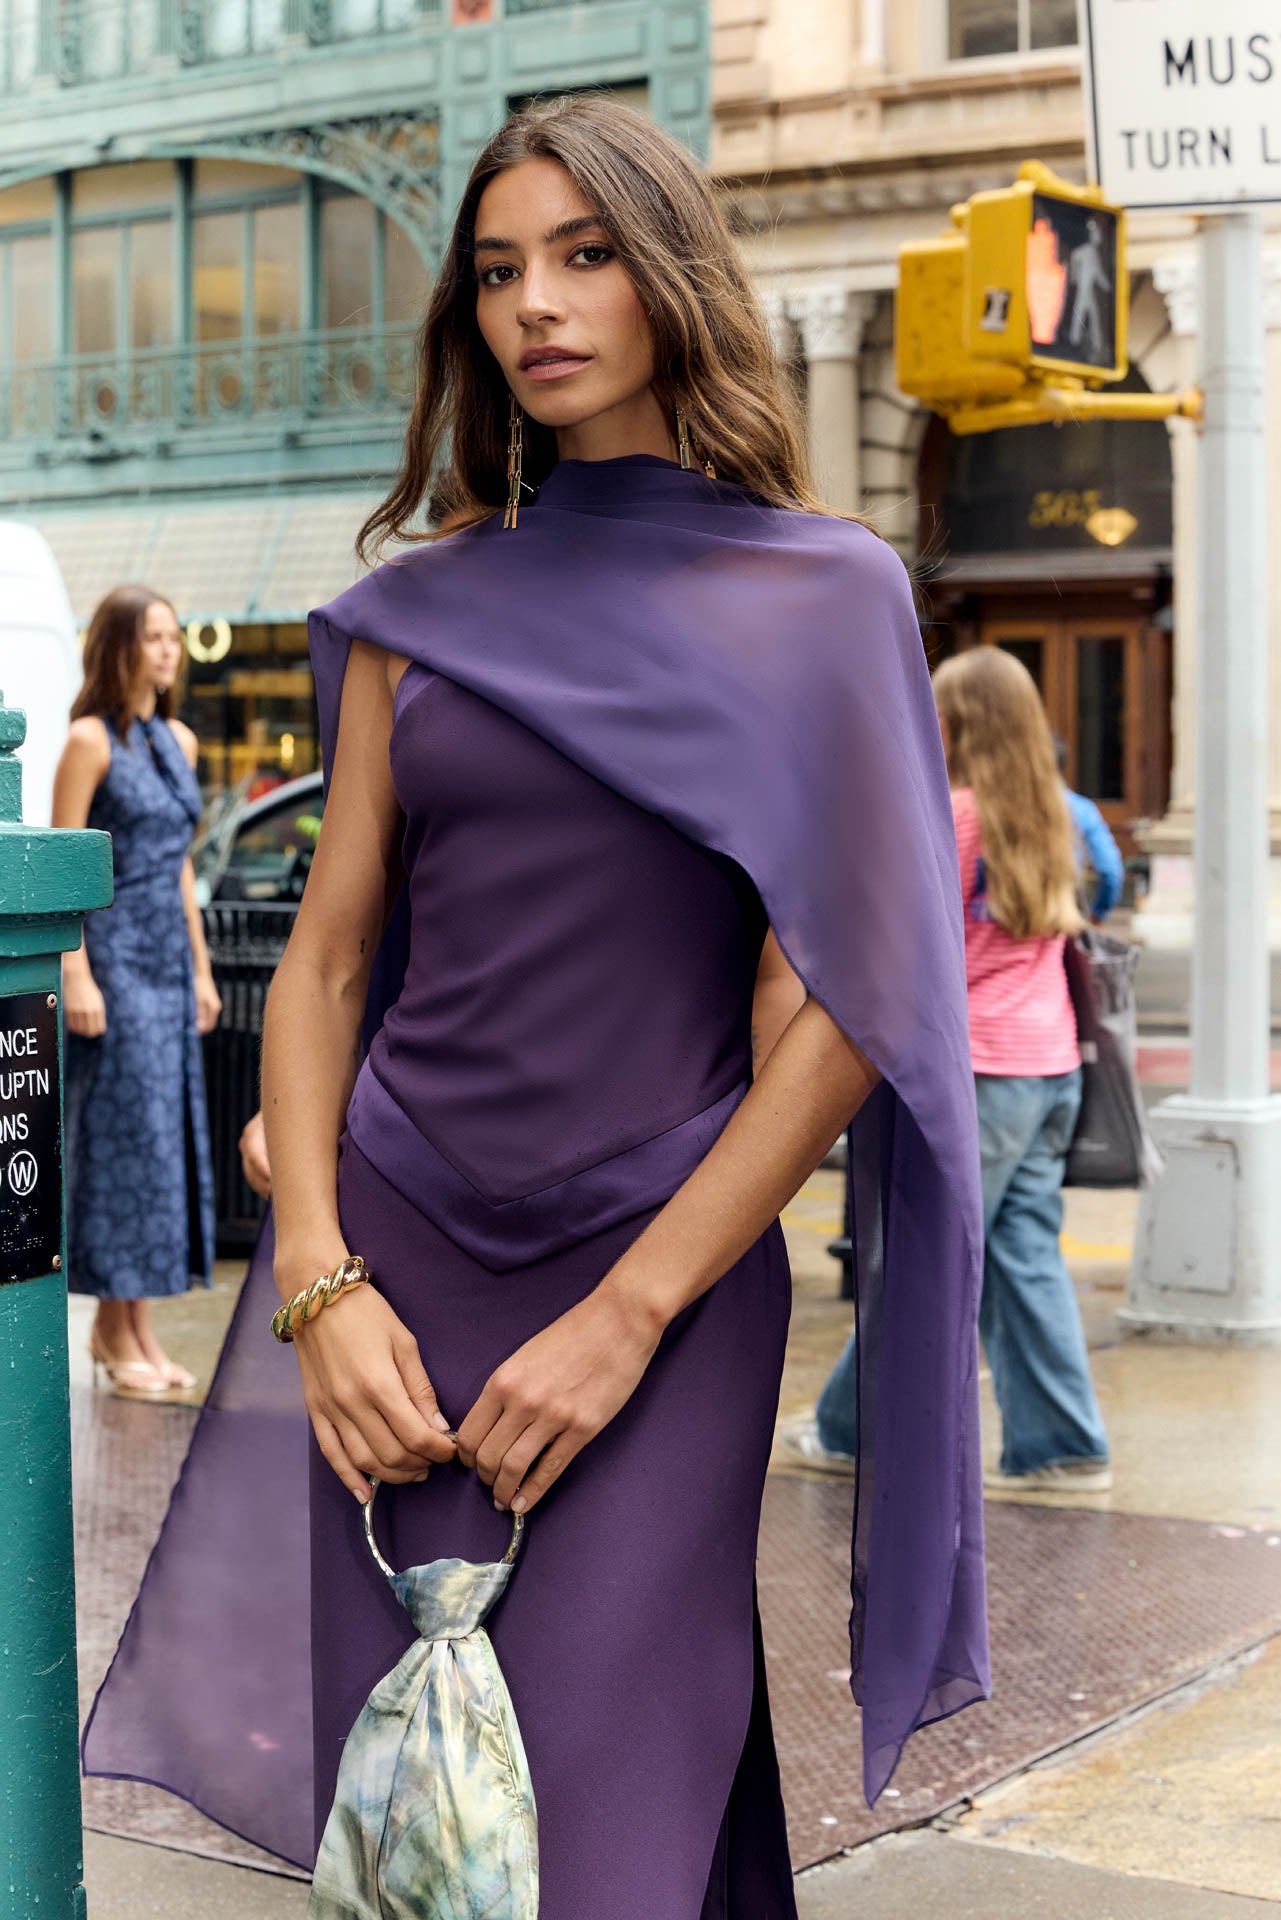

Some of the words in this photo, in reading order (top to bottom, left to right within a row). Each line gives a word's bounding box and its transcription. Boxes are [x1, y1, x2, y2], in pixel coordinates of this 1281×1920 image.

[1163, 34, 1273, 87] MUS
[1120, 127, 1233, 171] TURN
[1261, 125, 1281, 165] L
[0, 1027, 39, 1058] NCE
[0, 1068, 49, 1100] UPTN
[0, 1112, 29, 1144] NS
[11, 1158, 34, 1190] W
